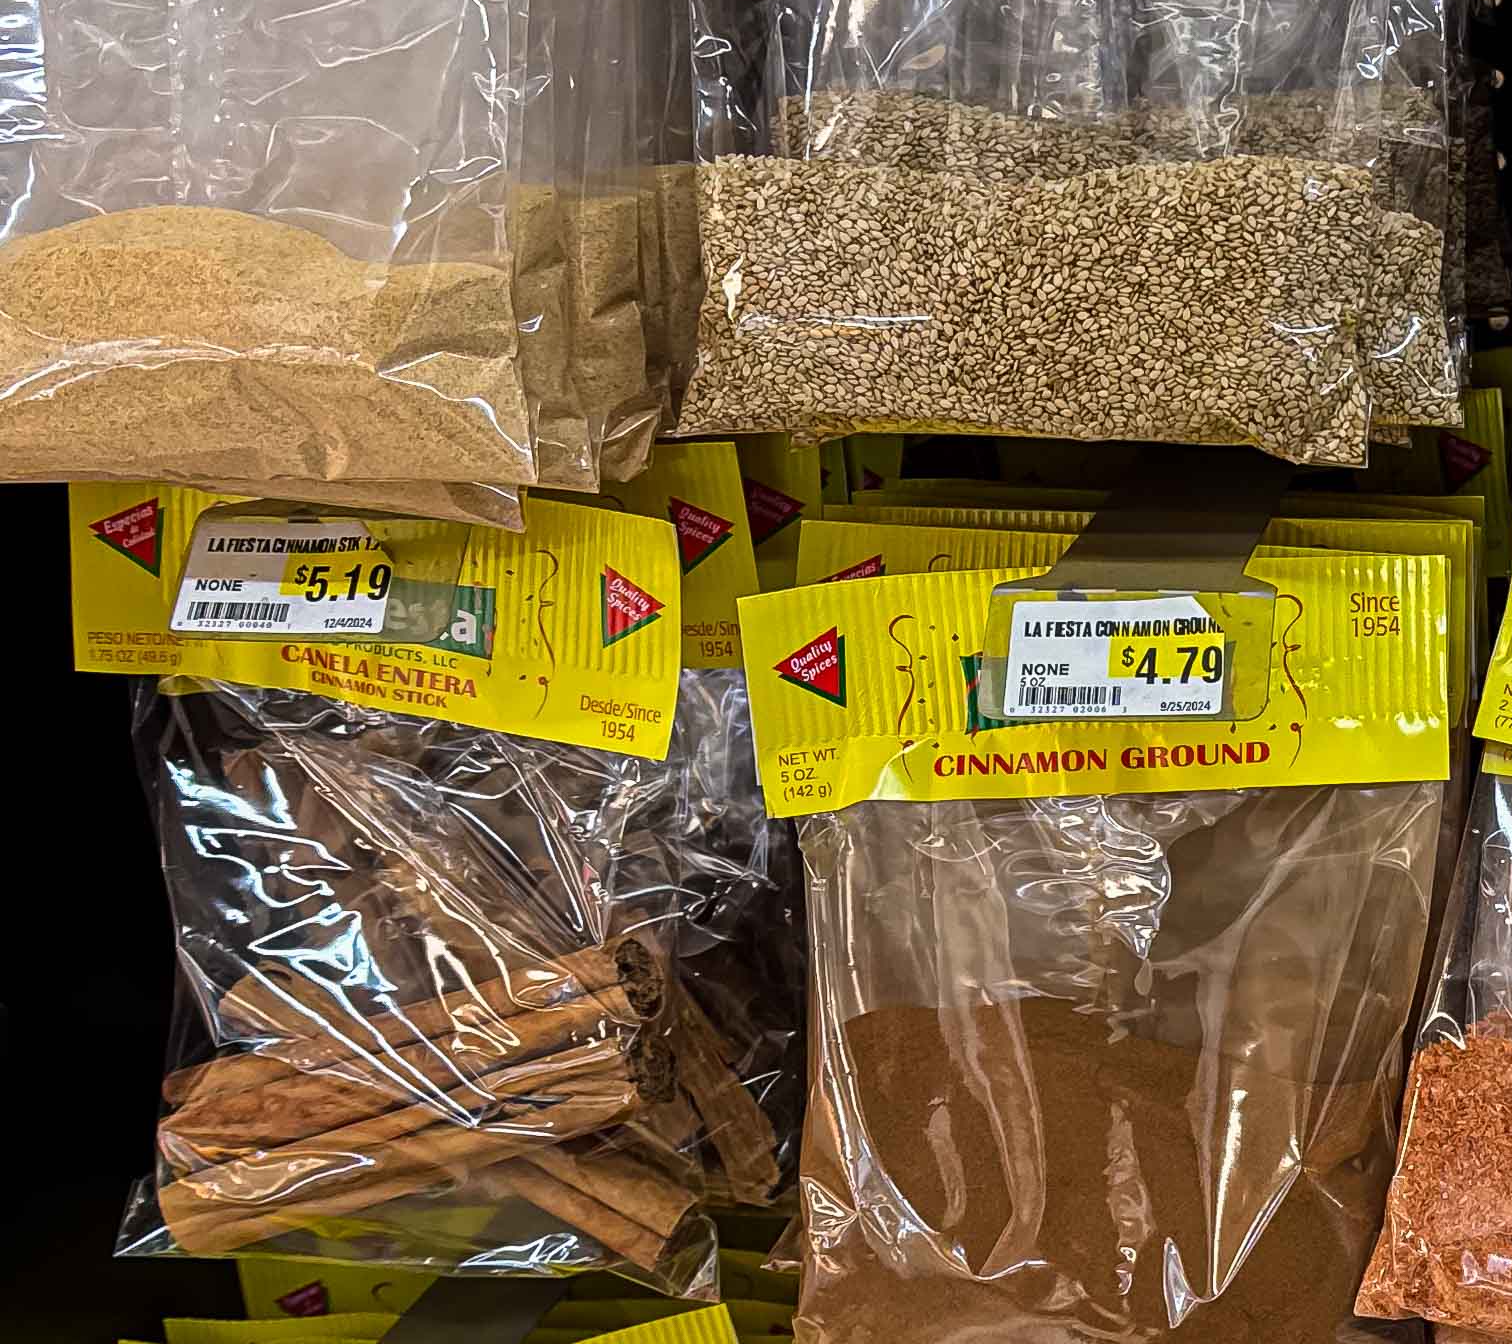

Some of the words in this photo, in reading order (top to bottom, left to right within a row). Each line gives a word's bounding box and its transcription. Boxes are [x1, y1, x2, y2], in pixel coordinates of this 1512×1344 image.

[195, 579, 244, 592] NONE
[294, 564, 392, 602] $5.19
[611, 578, 651, 612] Quality
[607, 592, 642, 621] Spices
[1350, 592, 1400, 613] Since
[1351, 616, 1401, 637] 1954
[433, 654, 459, 669] LLC
[699, 641, 733, 657] 1954
[790, 640, 833, 674] Quality
[281, 644, 369, 678] CANELA
[376, 664, 477, 699] ENTERA
[801, 654, 838, 682] Spices
[1021, 663, 1069, 676] NONE
[1122, 645, 1222, 684] $4.79
[312, 670, 386, 698] CINNAMON
[392, 689, 448, 708] STICK
[580, 695, 662, 723] Desde/Since
[600, 720, 636, 742] 1954
[933, 748, 1108, 778] CINNAMON
[1120, 741, 1271, 770] GROUND
